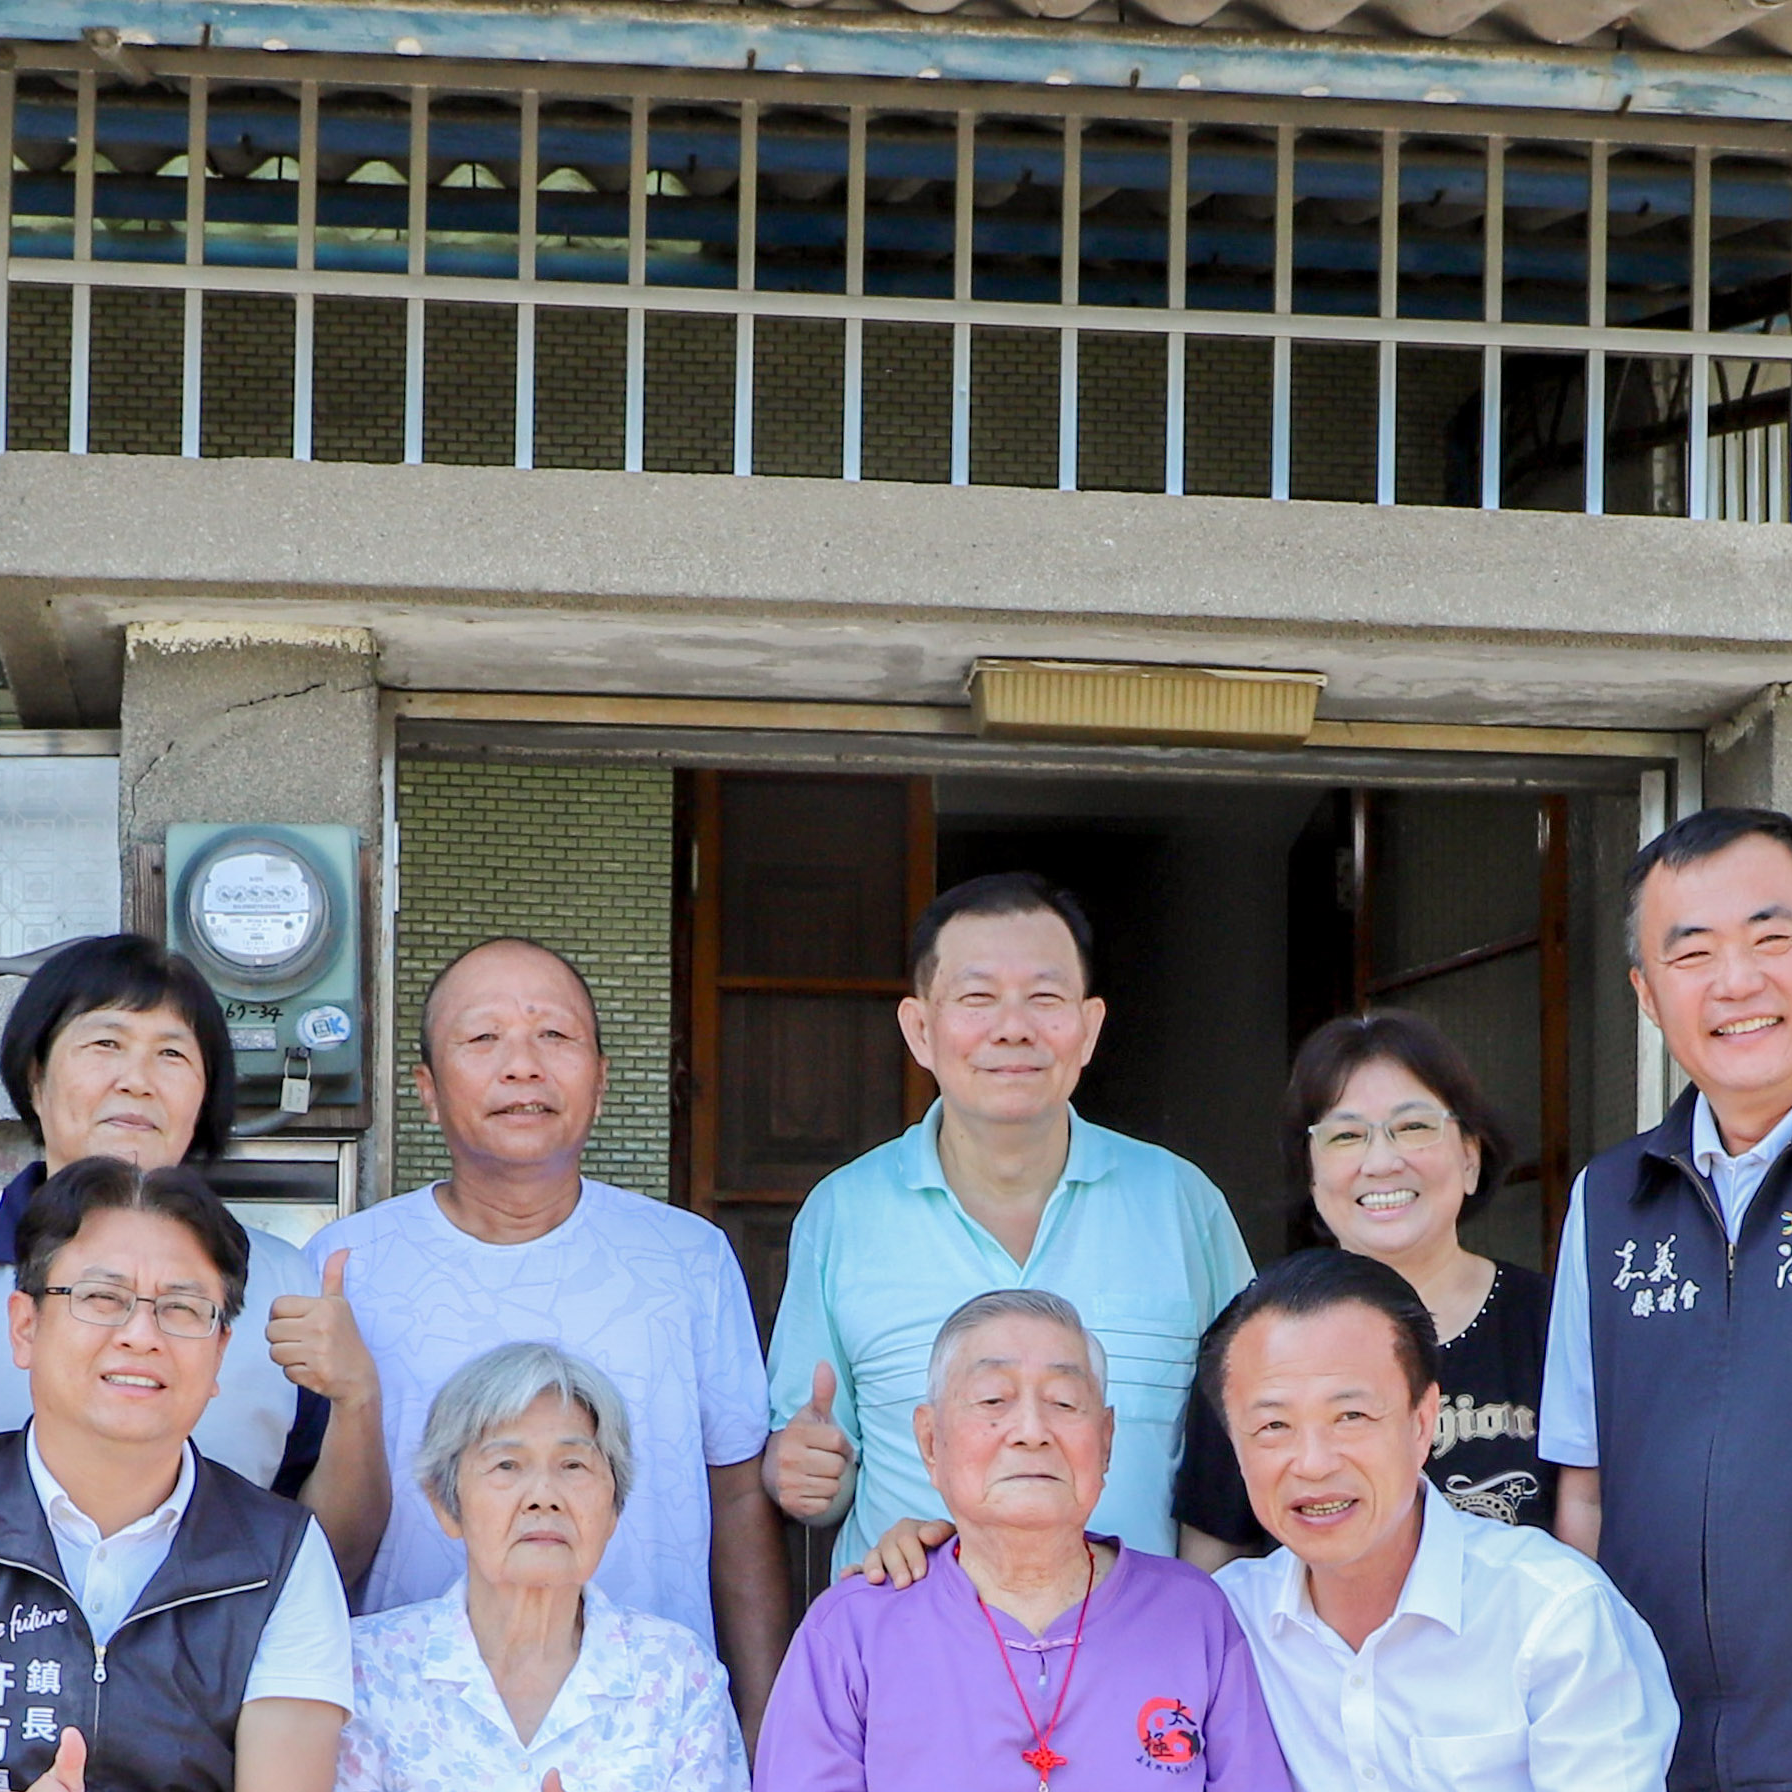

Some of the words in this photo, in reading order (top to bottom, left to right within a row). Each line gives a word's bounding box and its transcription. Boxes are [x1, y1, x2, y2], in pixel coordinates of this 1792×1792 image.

[1613, 1234, 1678, 1290] 嘉義
[10, 1604, 67, 1642] future
[22, 1659, 61, 1742] 鎮長
